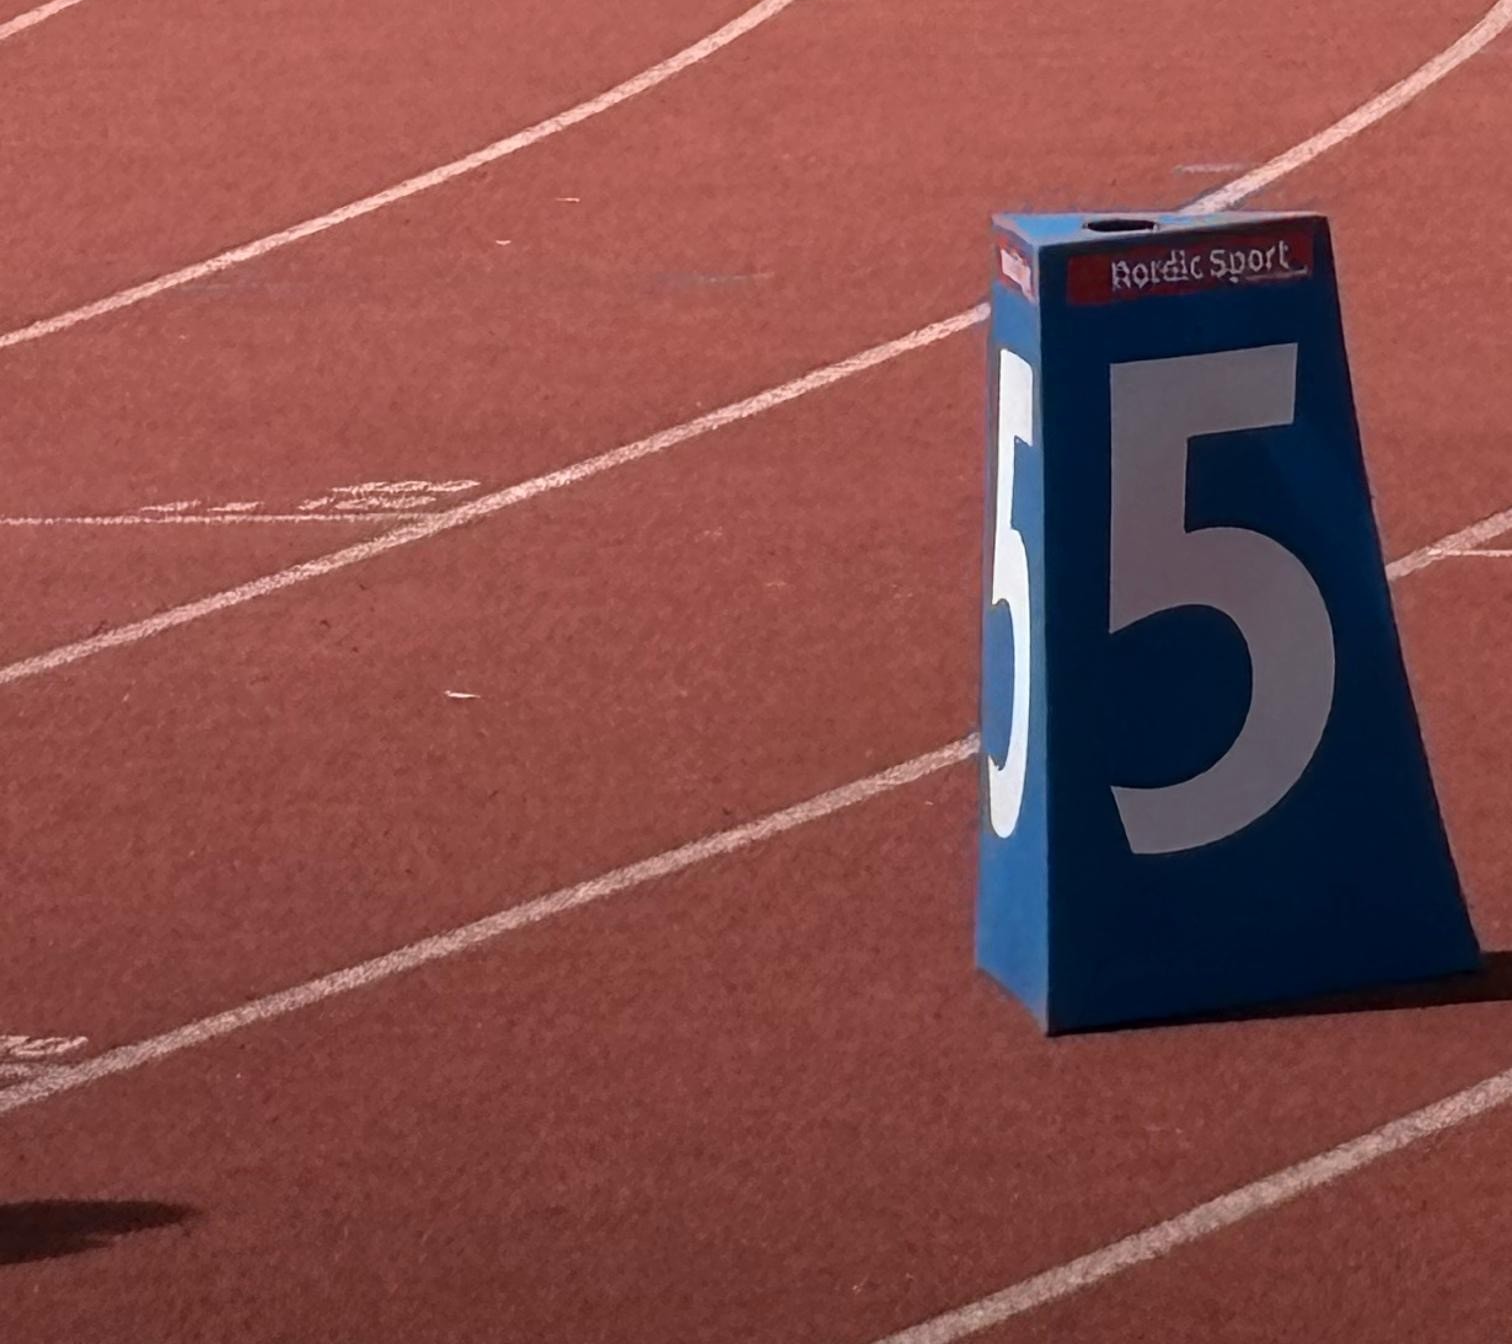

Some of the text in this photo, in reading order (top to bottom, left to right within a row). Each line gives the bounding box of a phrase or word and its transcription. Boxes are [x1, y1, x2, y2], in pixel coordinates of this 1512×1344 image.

[1111, 241, 1291, 291] Nordic Sport
[988, 349, 1033, 838] 5
[1110, 343, 1335, 854] 5
